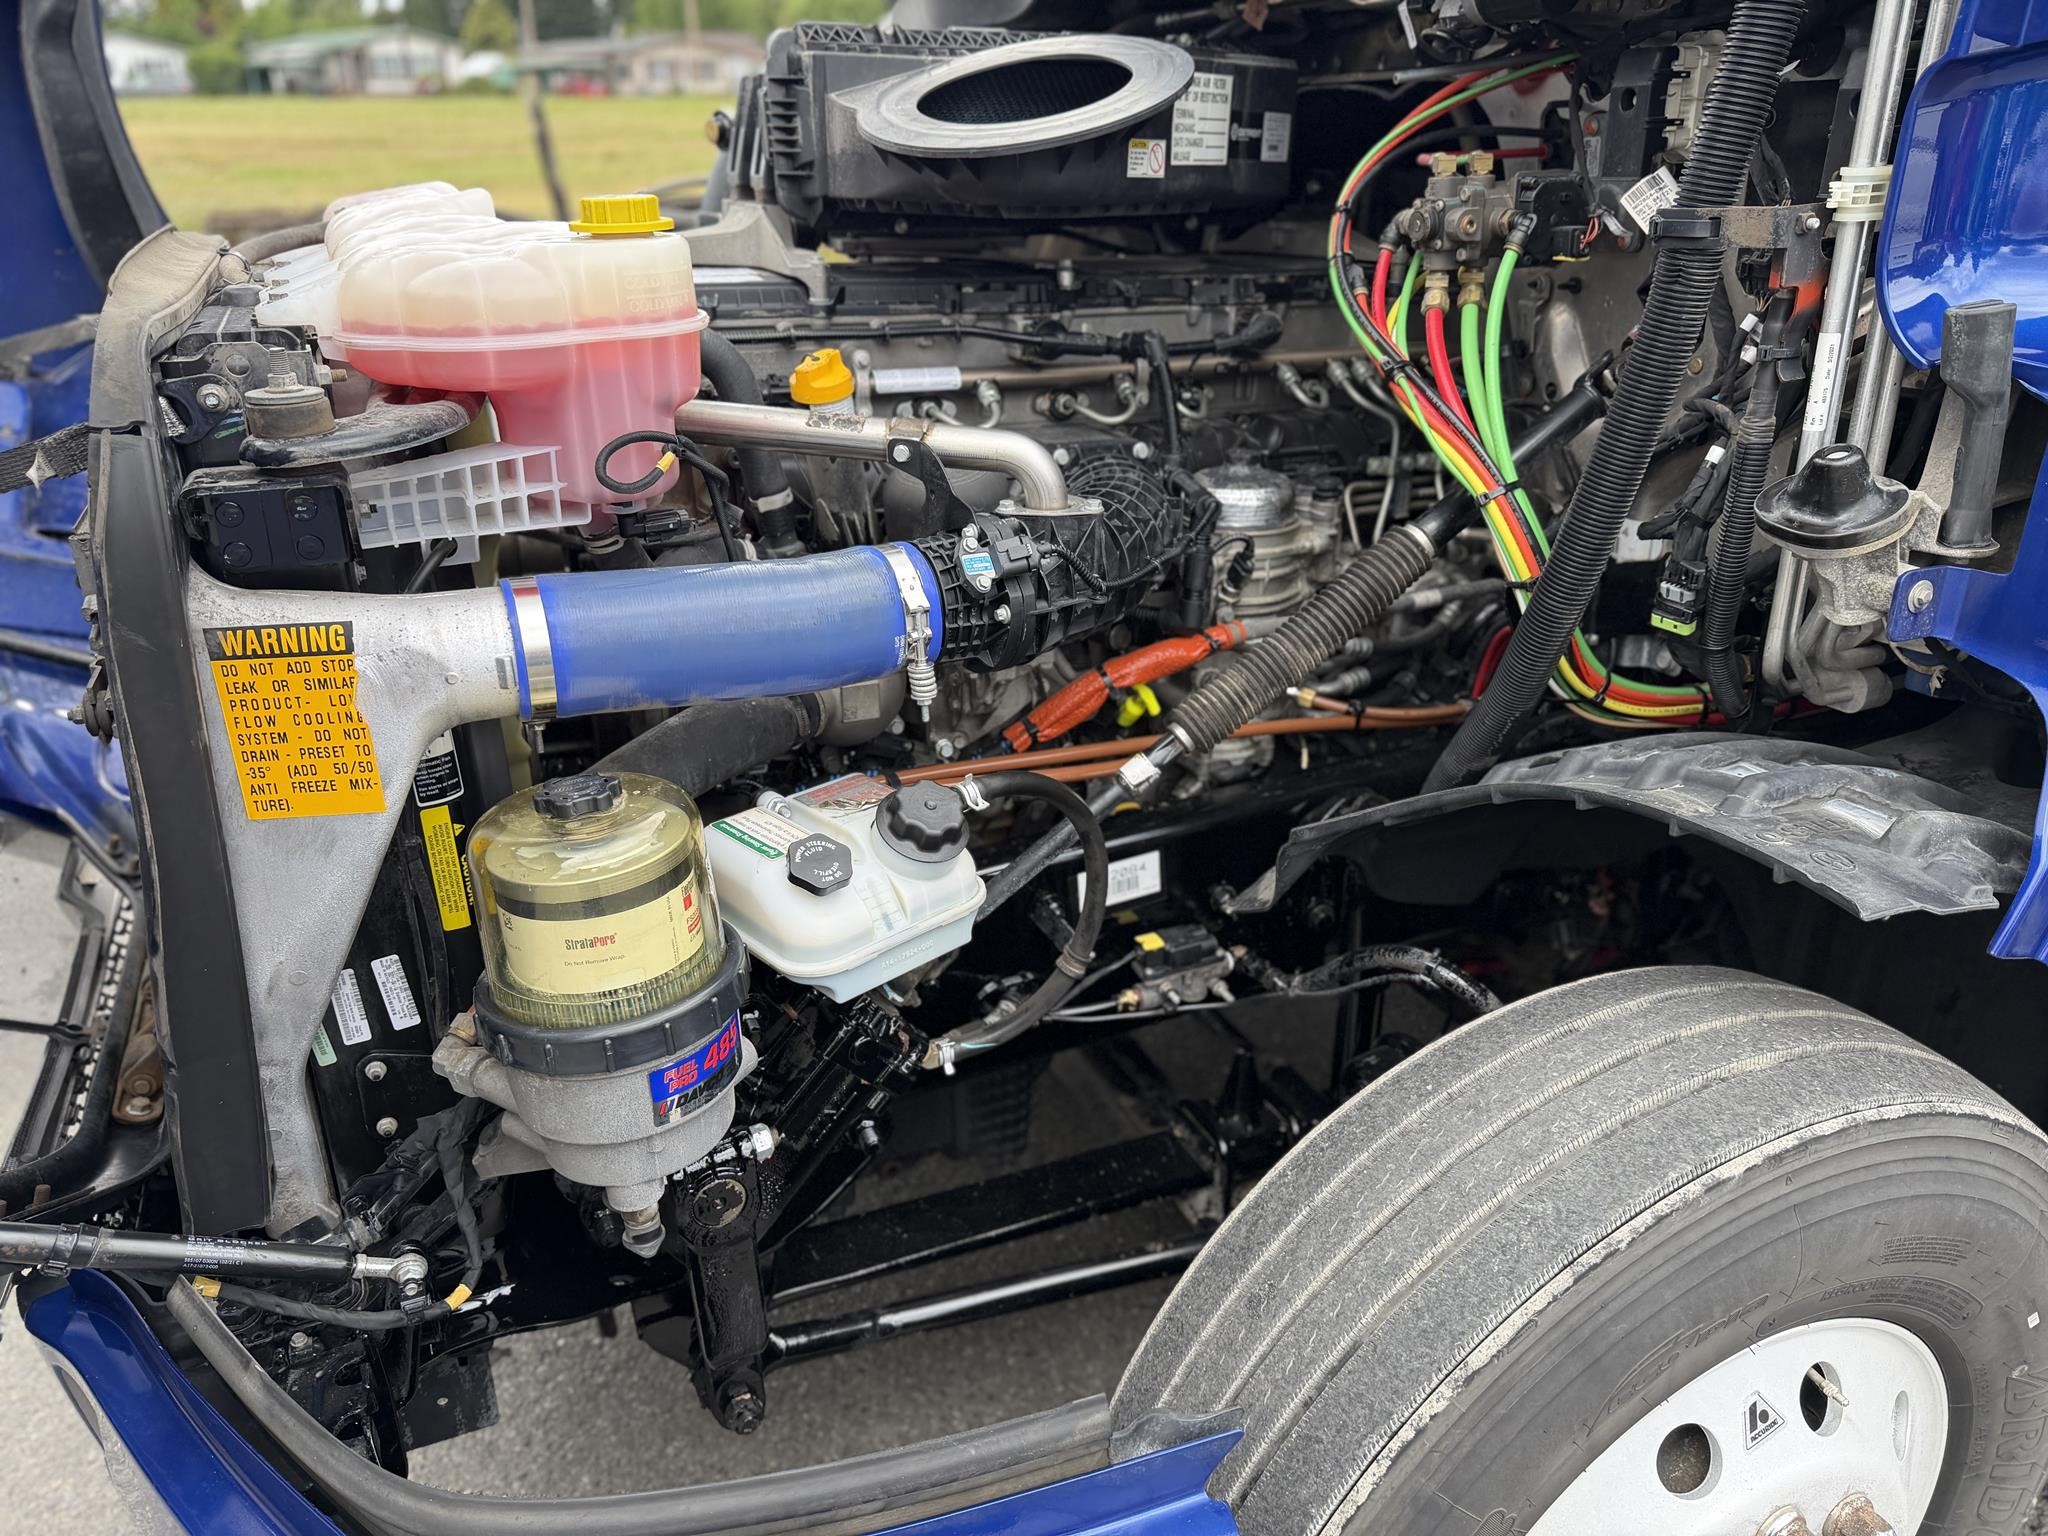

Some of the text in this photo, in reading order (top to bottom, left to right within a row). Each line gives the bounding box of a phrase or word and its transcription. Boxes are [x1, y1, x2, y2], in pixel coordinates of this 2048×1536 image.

[217, 624, 347, 657] WARNING
[221, 659, 354, 677] DO NOT ADD STOP
[225, 681, 258, 695] LEAK
[272, 679, 290, 693] OR
[229, 696, 311, 712] PRODUCT-
[234, 715, 277, 729] FLOW
[237, 731, 289, 746] SYSTEM
[315, 729, 331, 742] DO
[343, 727, 368, 741] NOT
[242, 749, 280, 763] DRAIN
[299, 745, 345, 760] PRESET
[355, 744, 371, 757] TO
[287, 763, 318, 778] (ADD
[333, 761, 374, 775] 50/50
[250, 777, 379, 797] ANTI FREEZE MIX-
[432, 825, 441, 848] WORKING
[805, 840, 837, 850] STEERING
[804, 846, 823, 857] FLUID
[431, 852, 439, 869] BEFORE
[834, 870, 844, 878] DO
[573, 959, 585, 967] Not
[664, 1059, 698, 1084] FUEL
[668, 1070, 698, 1094] PRO
[1750, 1417, 1779, 1443] ACCURIDE
